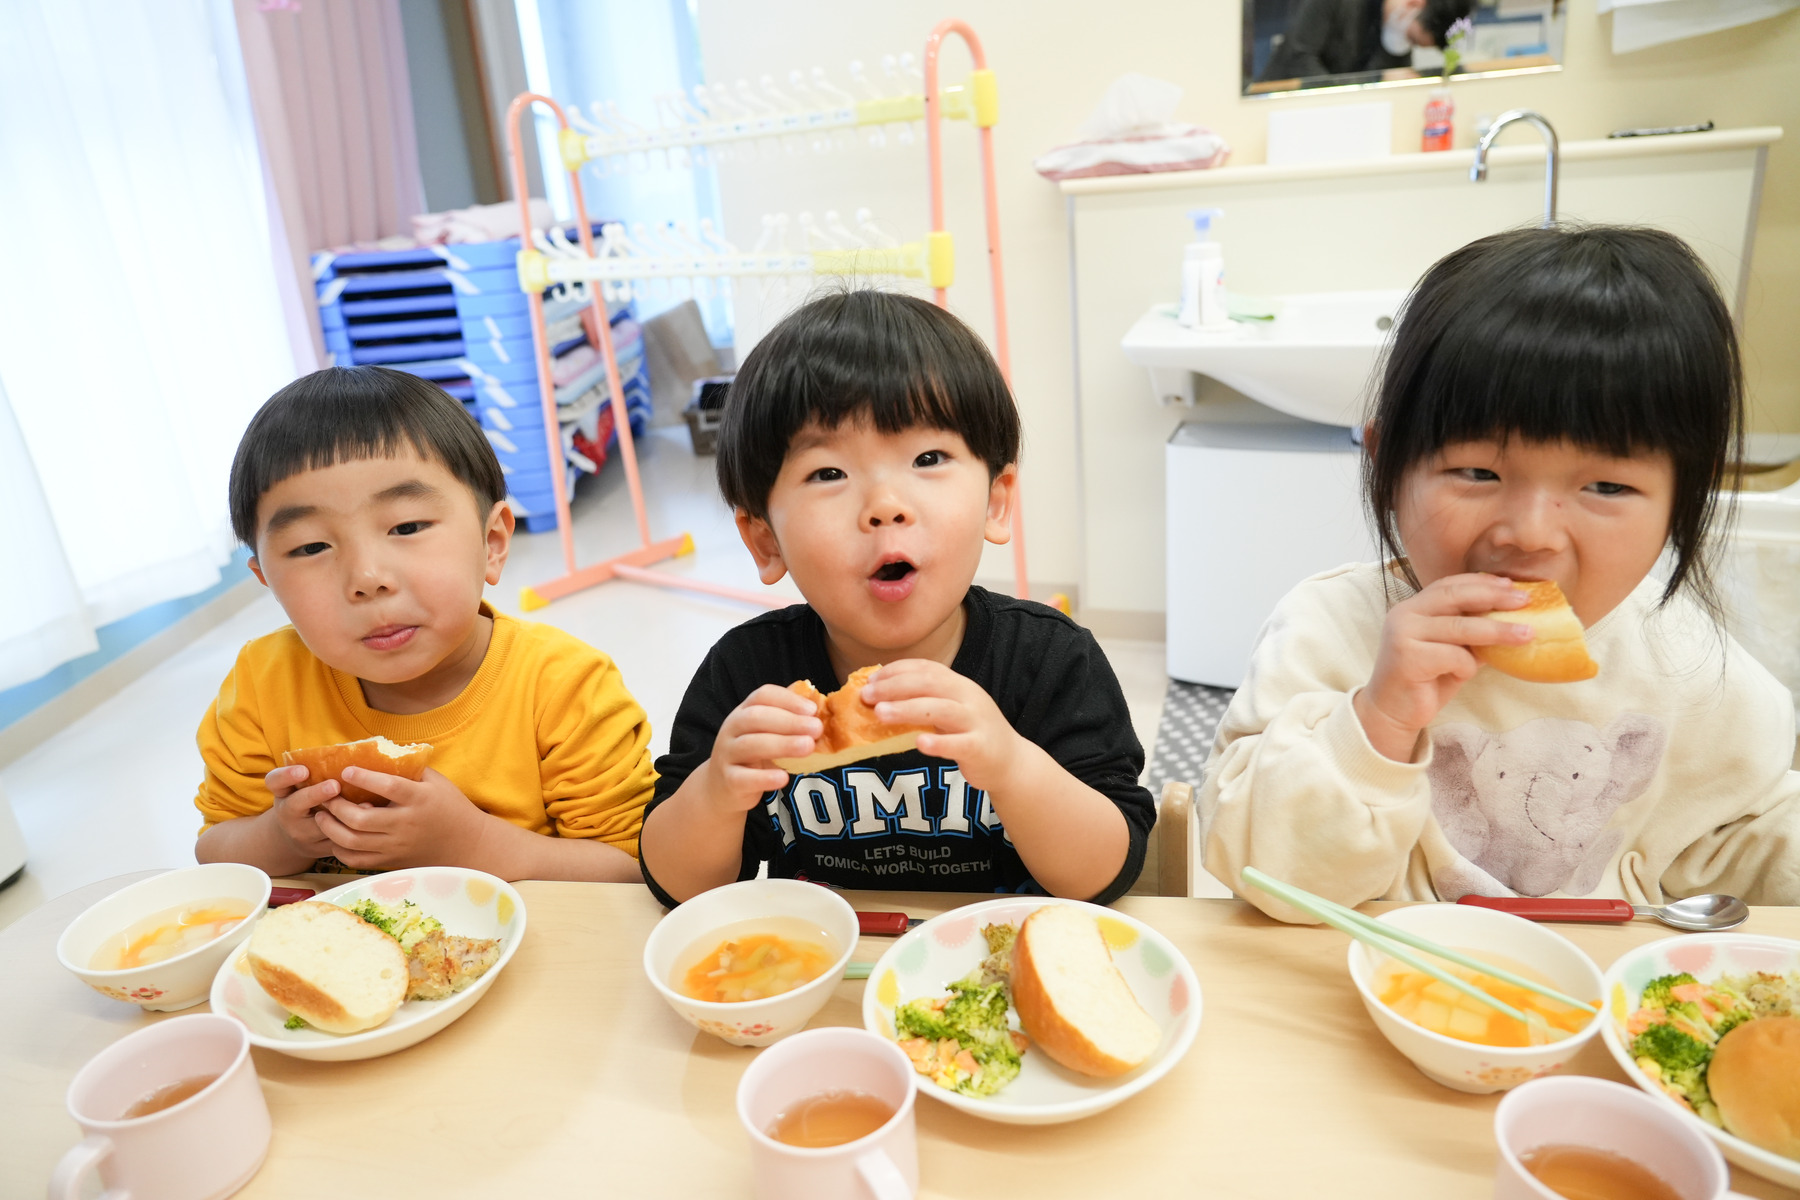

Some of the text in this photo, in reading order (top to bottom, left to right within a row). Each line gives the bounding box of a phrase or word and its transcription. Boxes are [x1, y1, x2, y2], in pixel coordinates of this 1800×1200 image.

[864, 844, 952, 860] LET'S BUILD
[814, 854, 992, 875] TOMICA WORLD TOGETH
